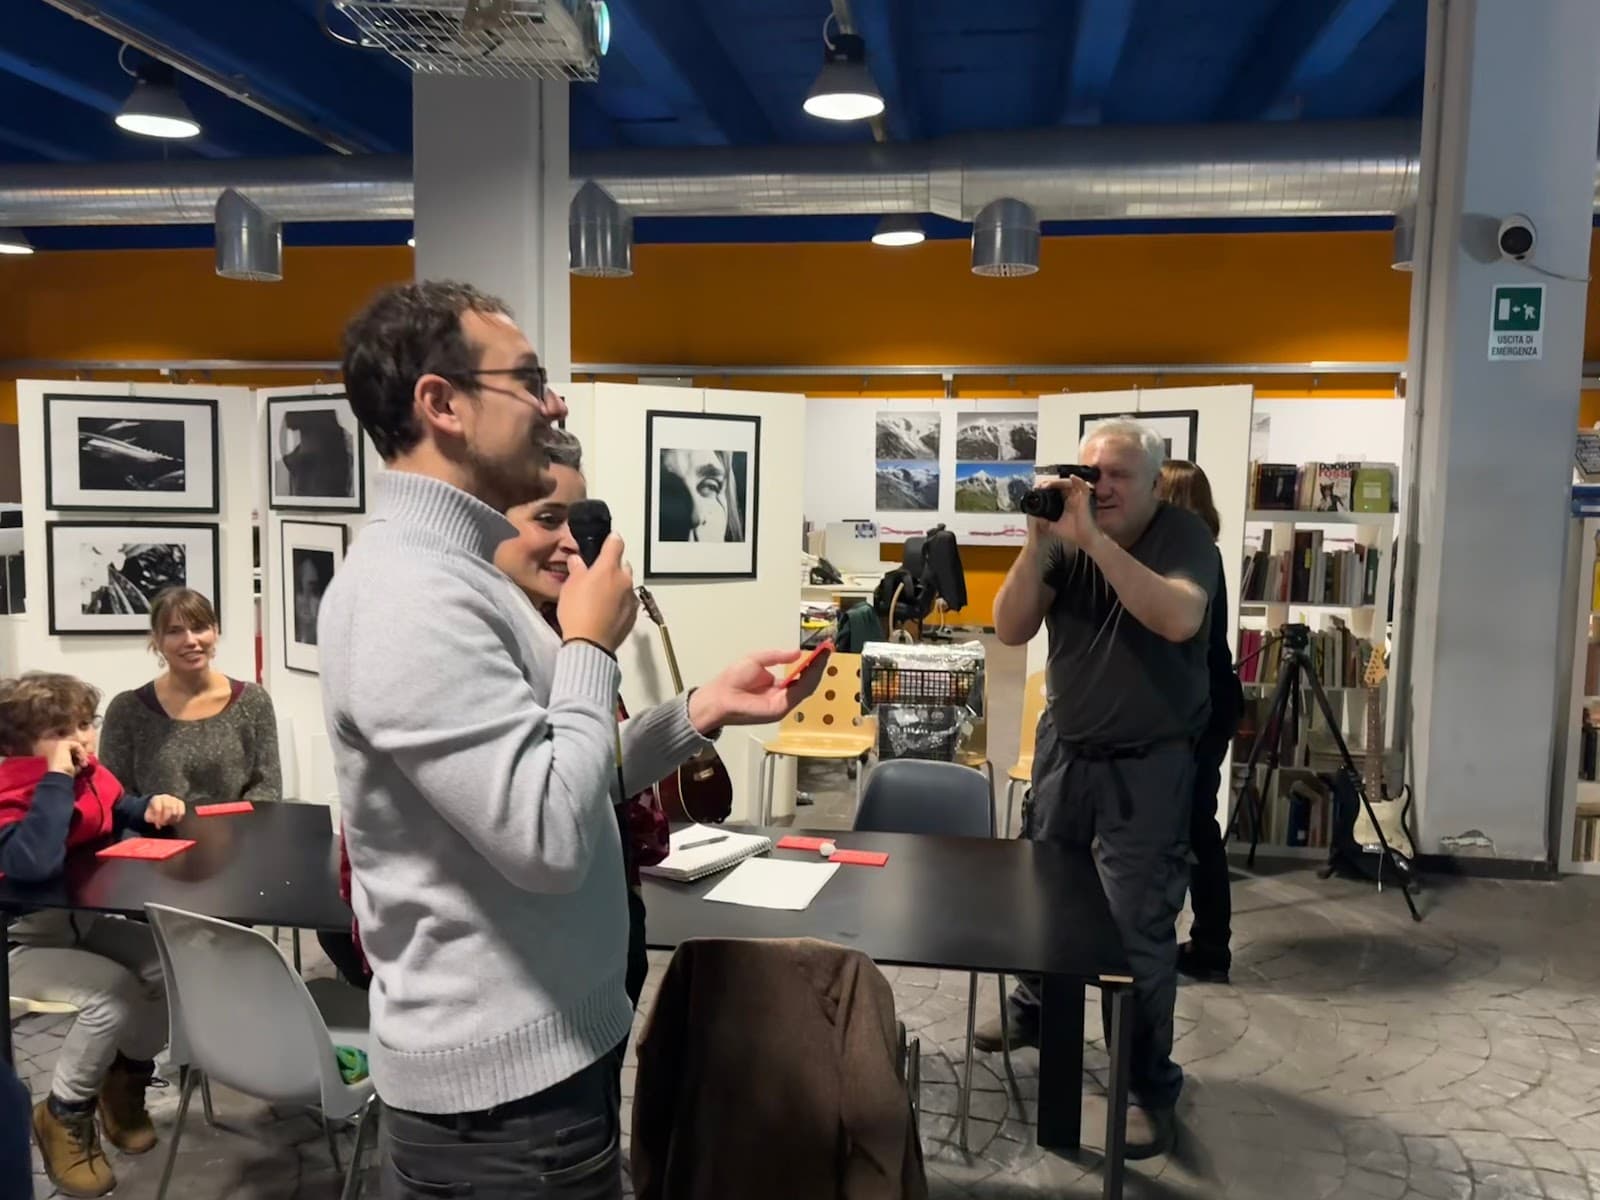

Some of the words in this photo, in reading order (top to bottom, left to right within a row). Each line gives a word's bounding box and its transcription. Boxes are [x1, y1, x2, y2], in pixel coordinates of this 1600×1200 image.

[1497, 335, 1523, 344] USCITA
[1525, 335, 1534, 344] DI
[1491, 346, 1537, 356] EMERGENZA
